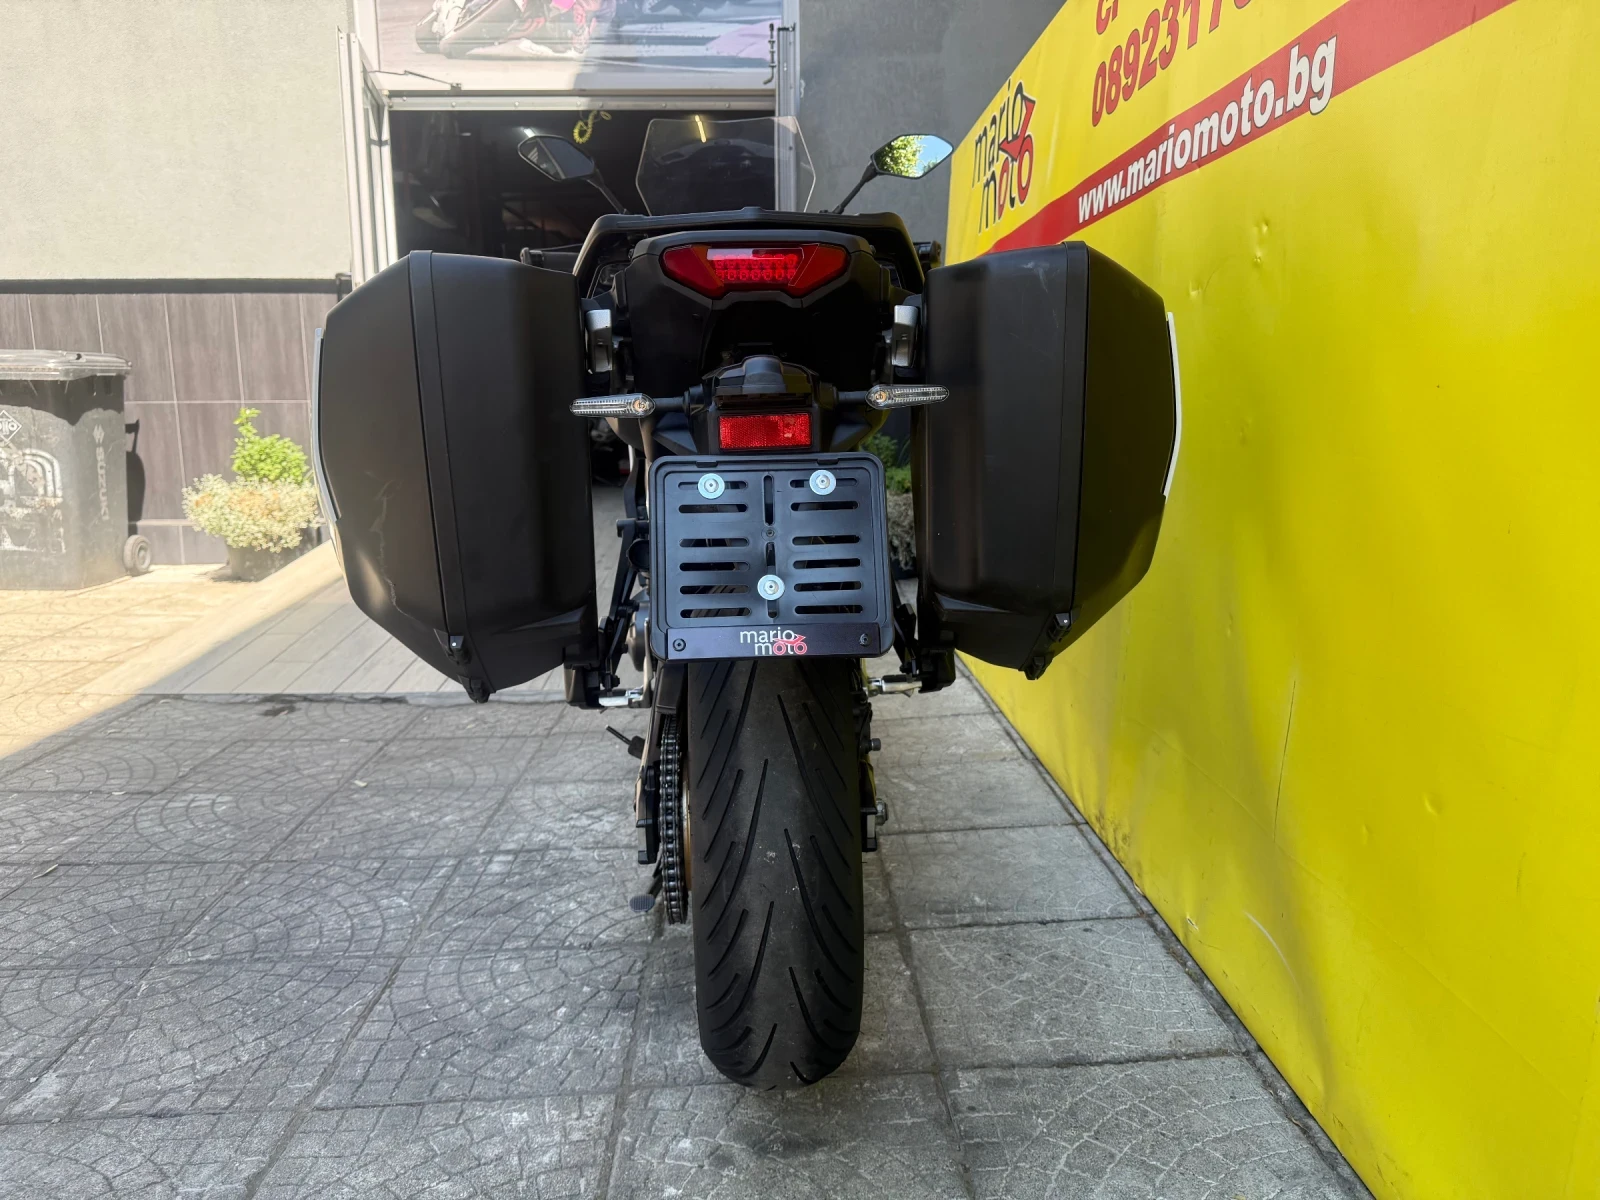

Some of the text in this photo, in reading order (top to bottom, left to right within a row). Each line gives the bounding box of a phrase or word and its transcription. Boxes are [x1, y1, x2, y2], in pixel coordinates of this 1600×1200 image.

[972, 78, 1024, 188] mario
[1078, 35, 1337, 224] www.mariomoto.bg
[978, 134, 1034, 234] moto
[740, 626, 795, 643] mario
[755, 641, 808, 655] moto
